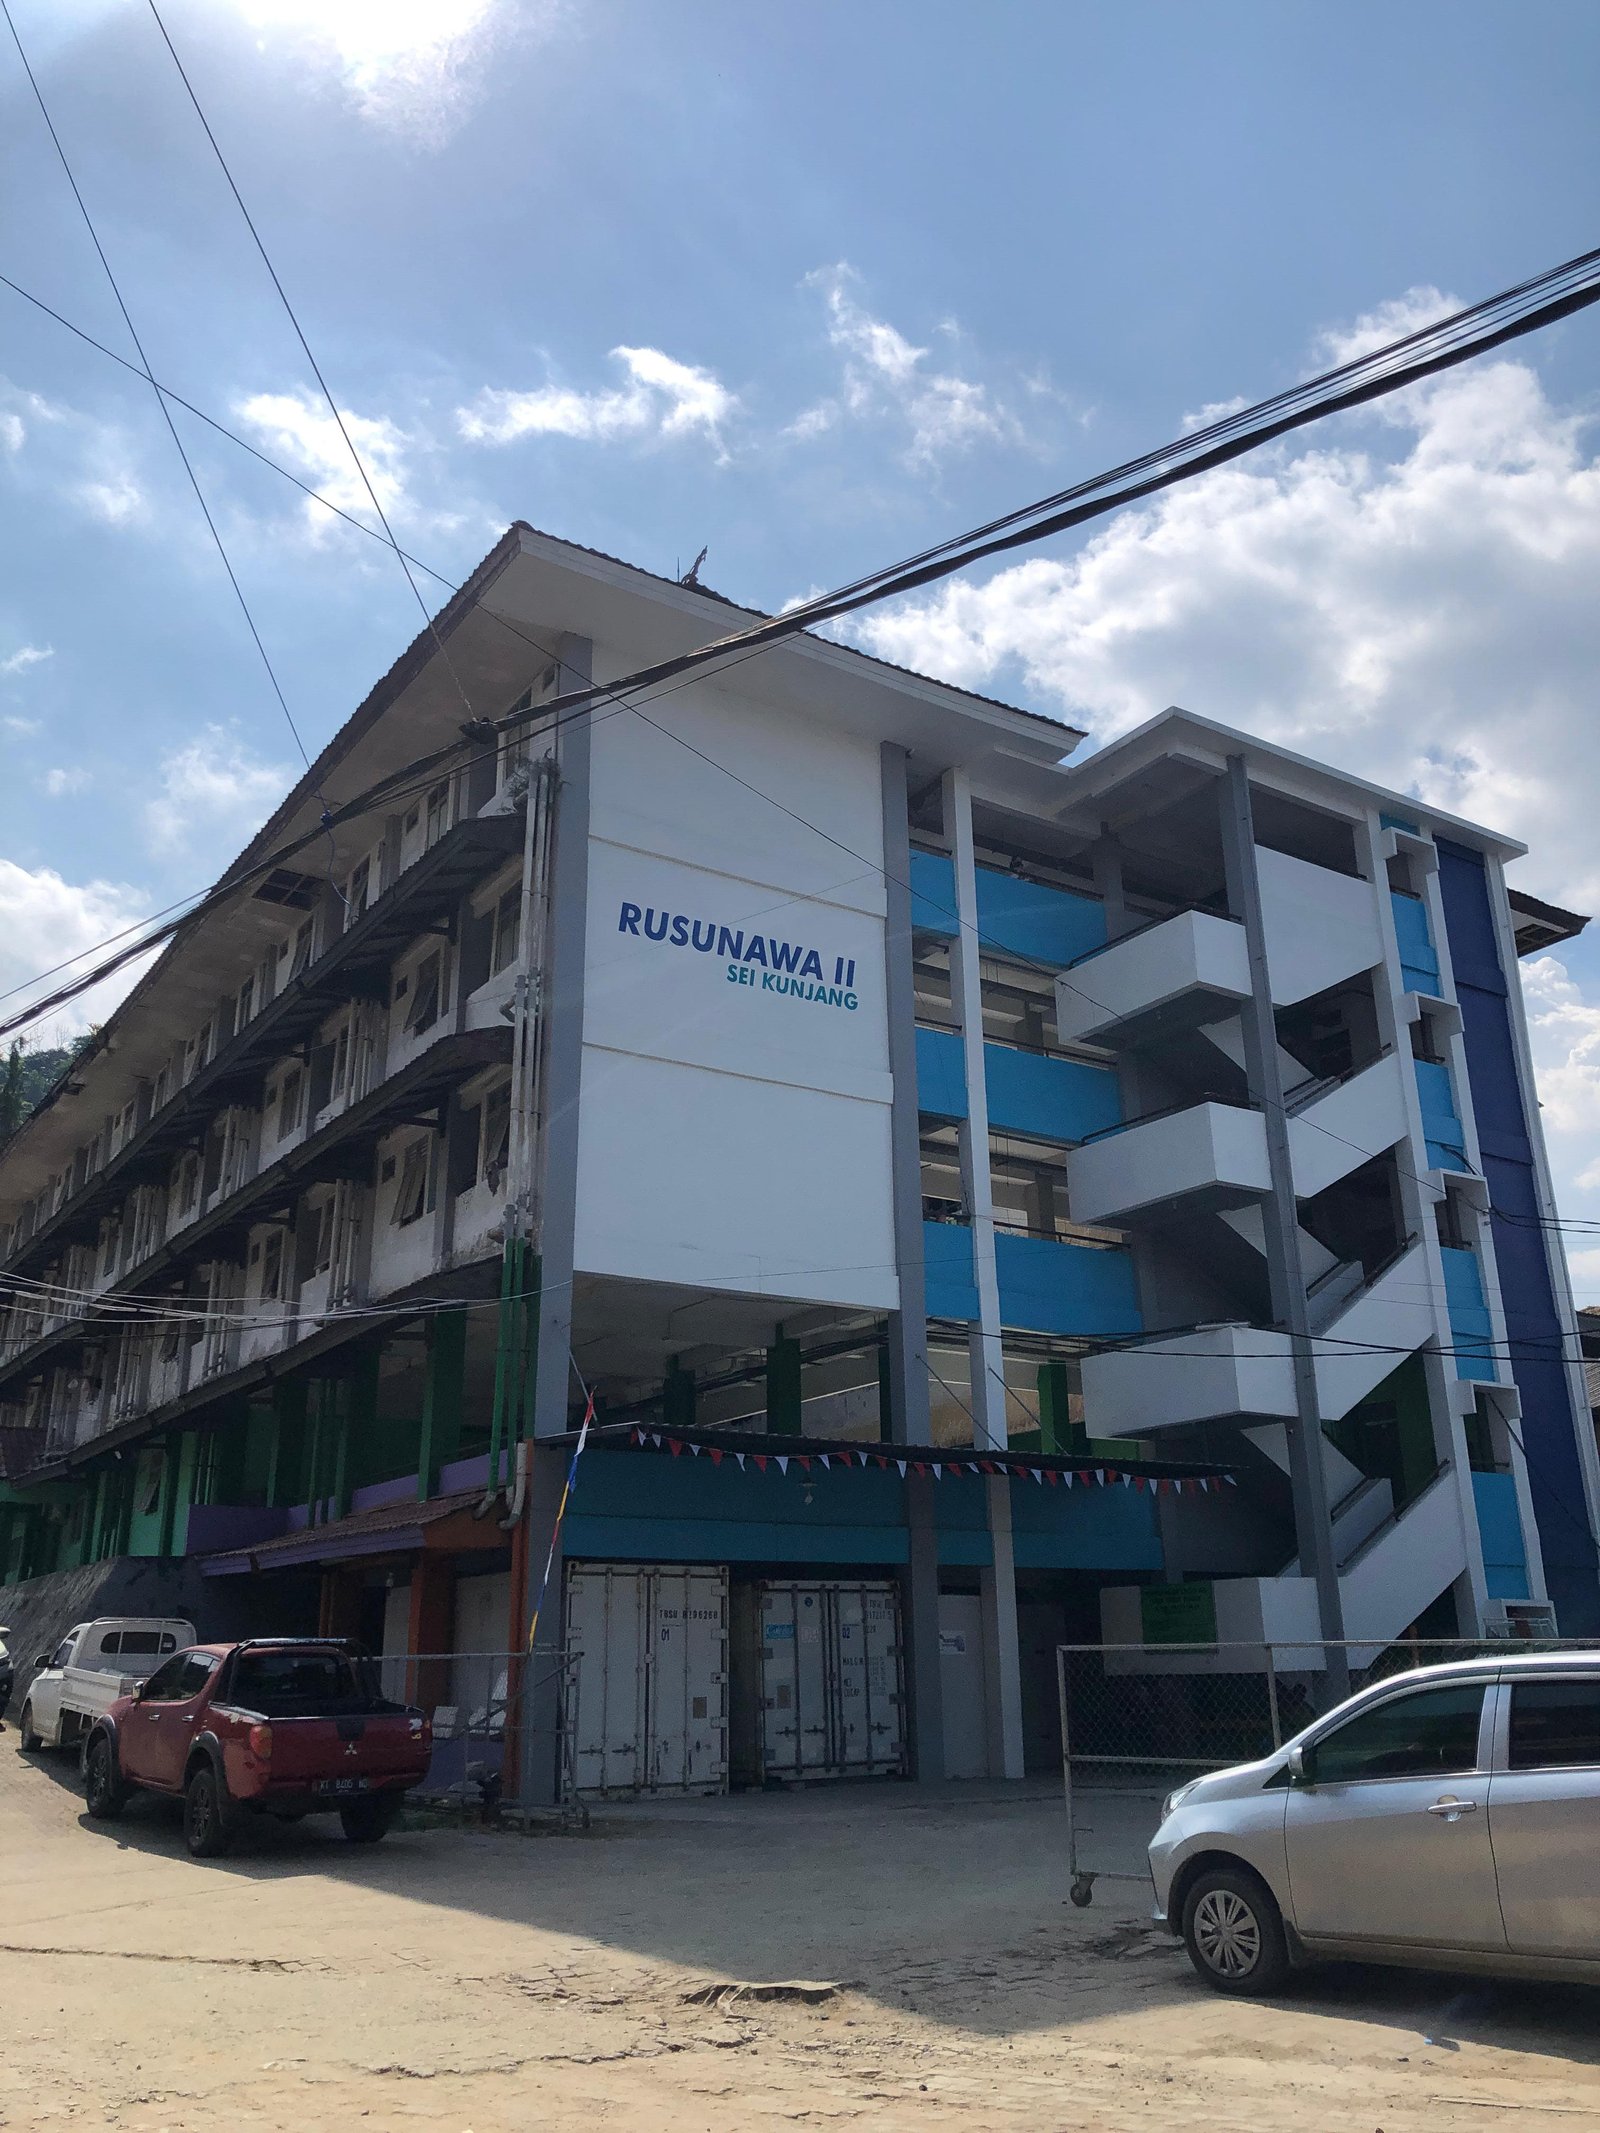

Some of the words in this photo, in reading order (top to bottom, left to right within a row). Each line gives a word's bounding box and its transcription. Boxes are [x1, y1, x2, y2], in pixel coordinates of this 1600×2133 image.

[618, 902, 823, 980] RUSUNAWA
[834, 957, 856, 988] II
[726, 964, 755, 987] SEI
[762, 972, 859, 1011] KUNJANG
